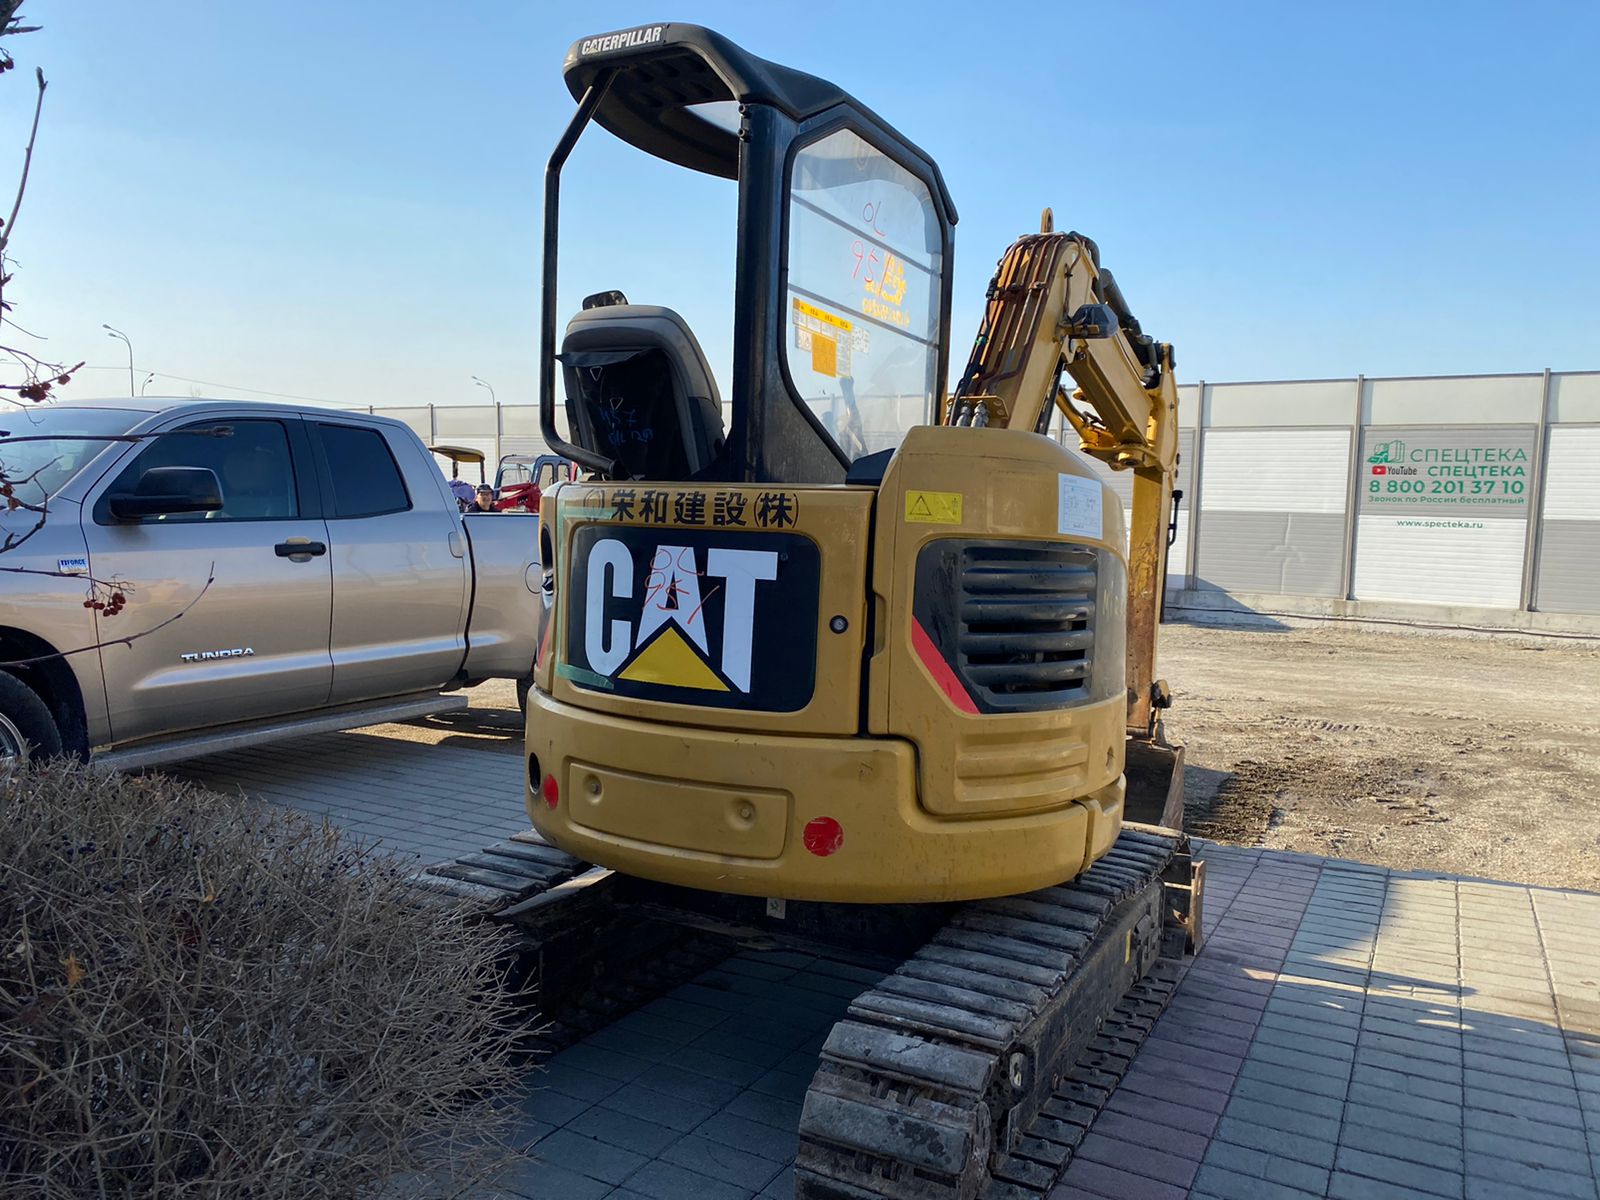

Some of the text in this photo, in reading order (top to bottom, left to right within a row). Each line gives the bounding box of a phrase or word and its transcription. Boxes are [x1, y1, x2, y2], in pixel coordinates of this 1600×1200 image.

[581, 26, 662, 55] CATERPILLAR
[1410, 448, 1528, 464] СПЕЦТЕКА
[1387, 466, 1418, 476] YouTube
[1427, 465, 1526, 479] СПЕЦТЕКА
[1369, 480, 1525, 495] 8 800 201 37 10
[1368, 495, 1404, 503] Звонок
[1421, 496, 1457, 504] России
[1460, 496, 1525, 504] бесплатный
[1396, 520, 1484, 529] www.specteka.ru
[585, 538, 779, 693] CAT
[180, 647, 255, 663] TUNDRA
